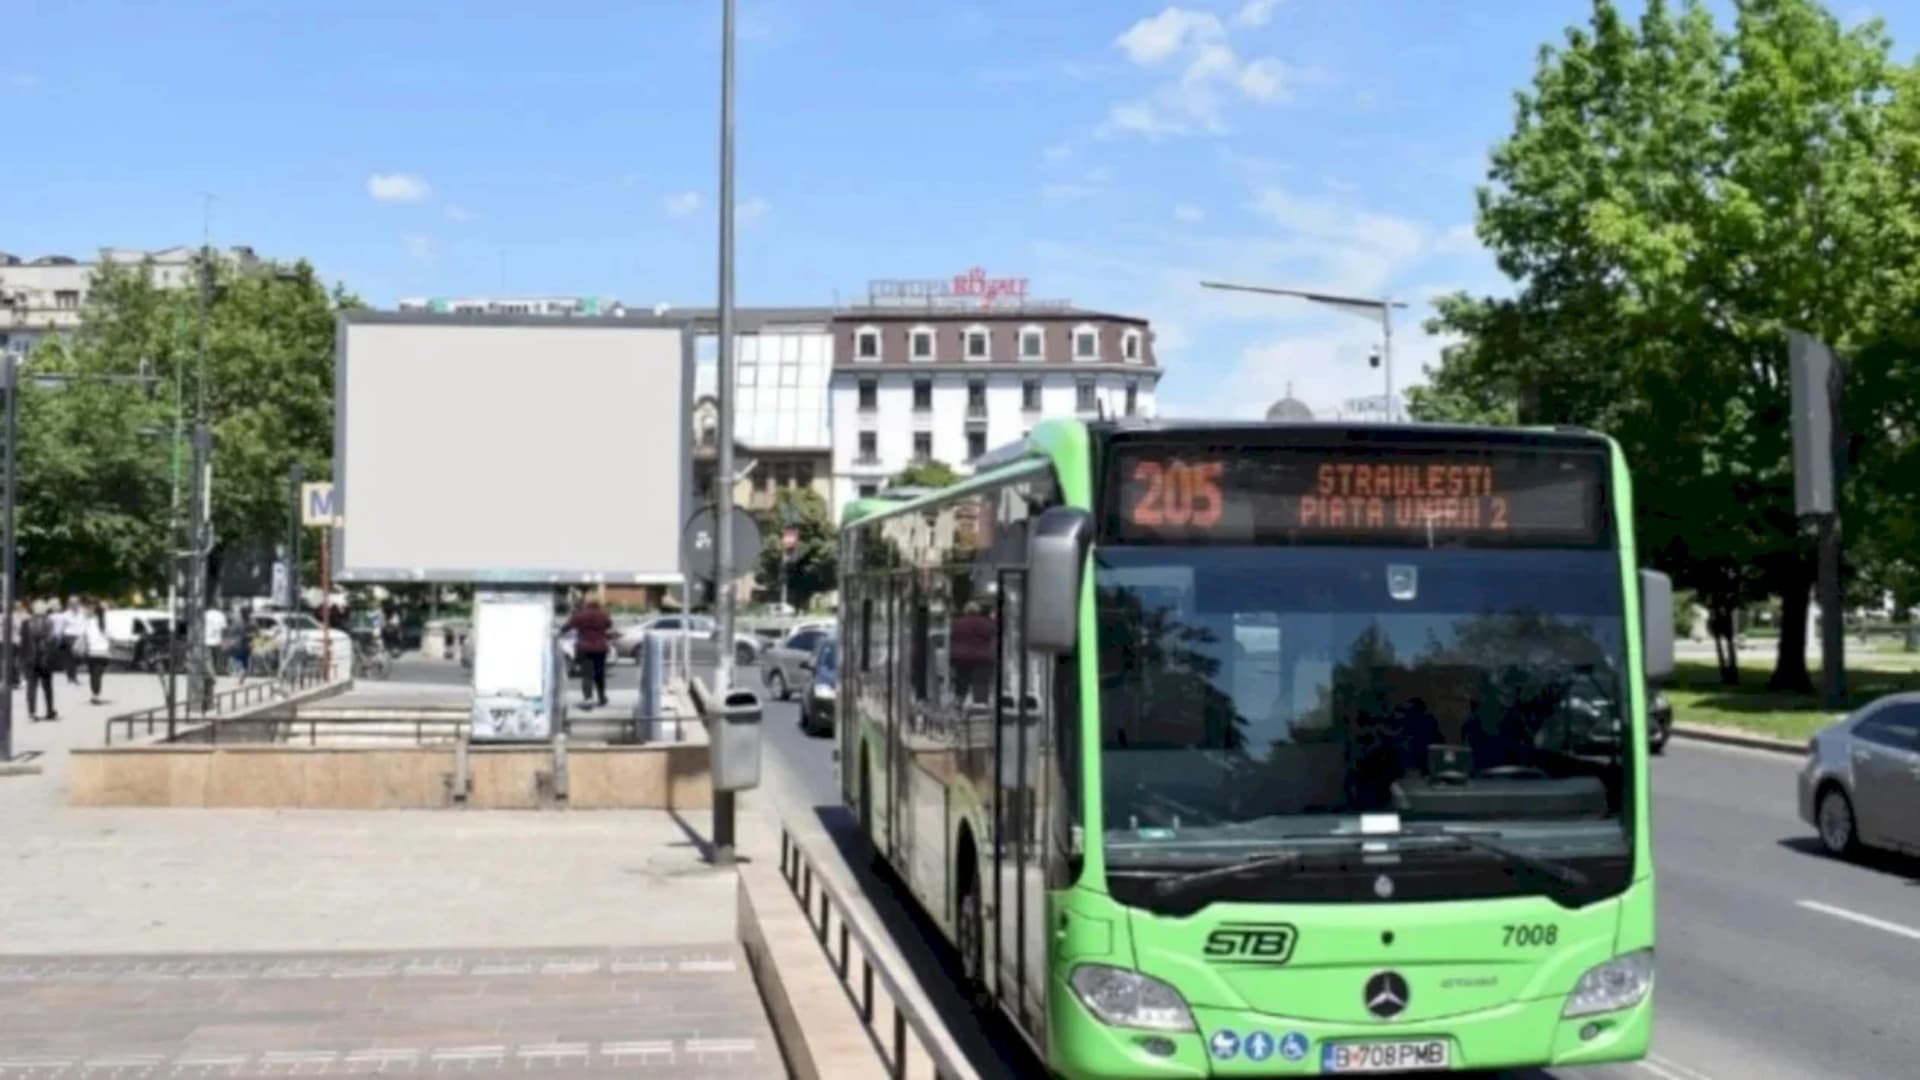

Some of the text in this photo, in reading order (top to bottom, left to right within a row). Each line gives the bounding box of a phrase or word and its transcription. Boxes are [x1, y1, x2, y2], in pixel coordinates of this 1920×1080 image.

[1133, 461, 1223, 527] 205
[1317, 463, 1492, 495] STRAULESTI
[1300, 497, 1385, 528] PIATA
[1490, 497, 1509, 529] 2
[1203, 929, 1288, 957] STB
[1501, 923, 1559, 947] 7008
